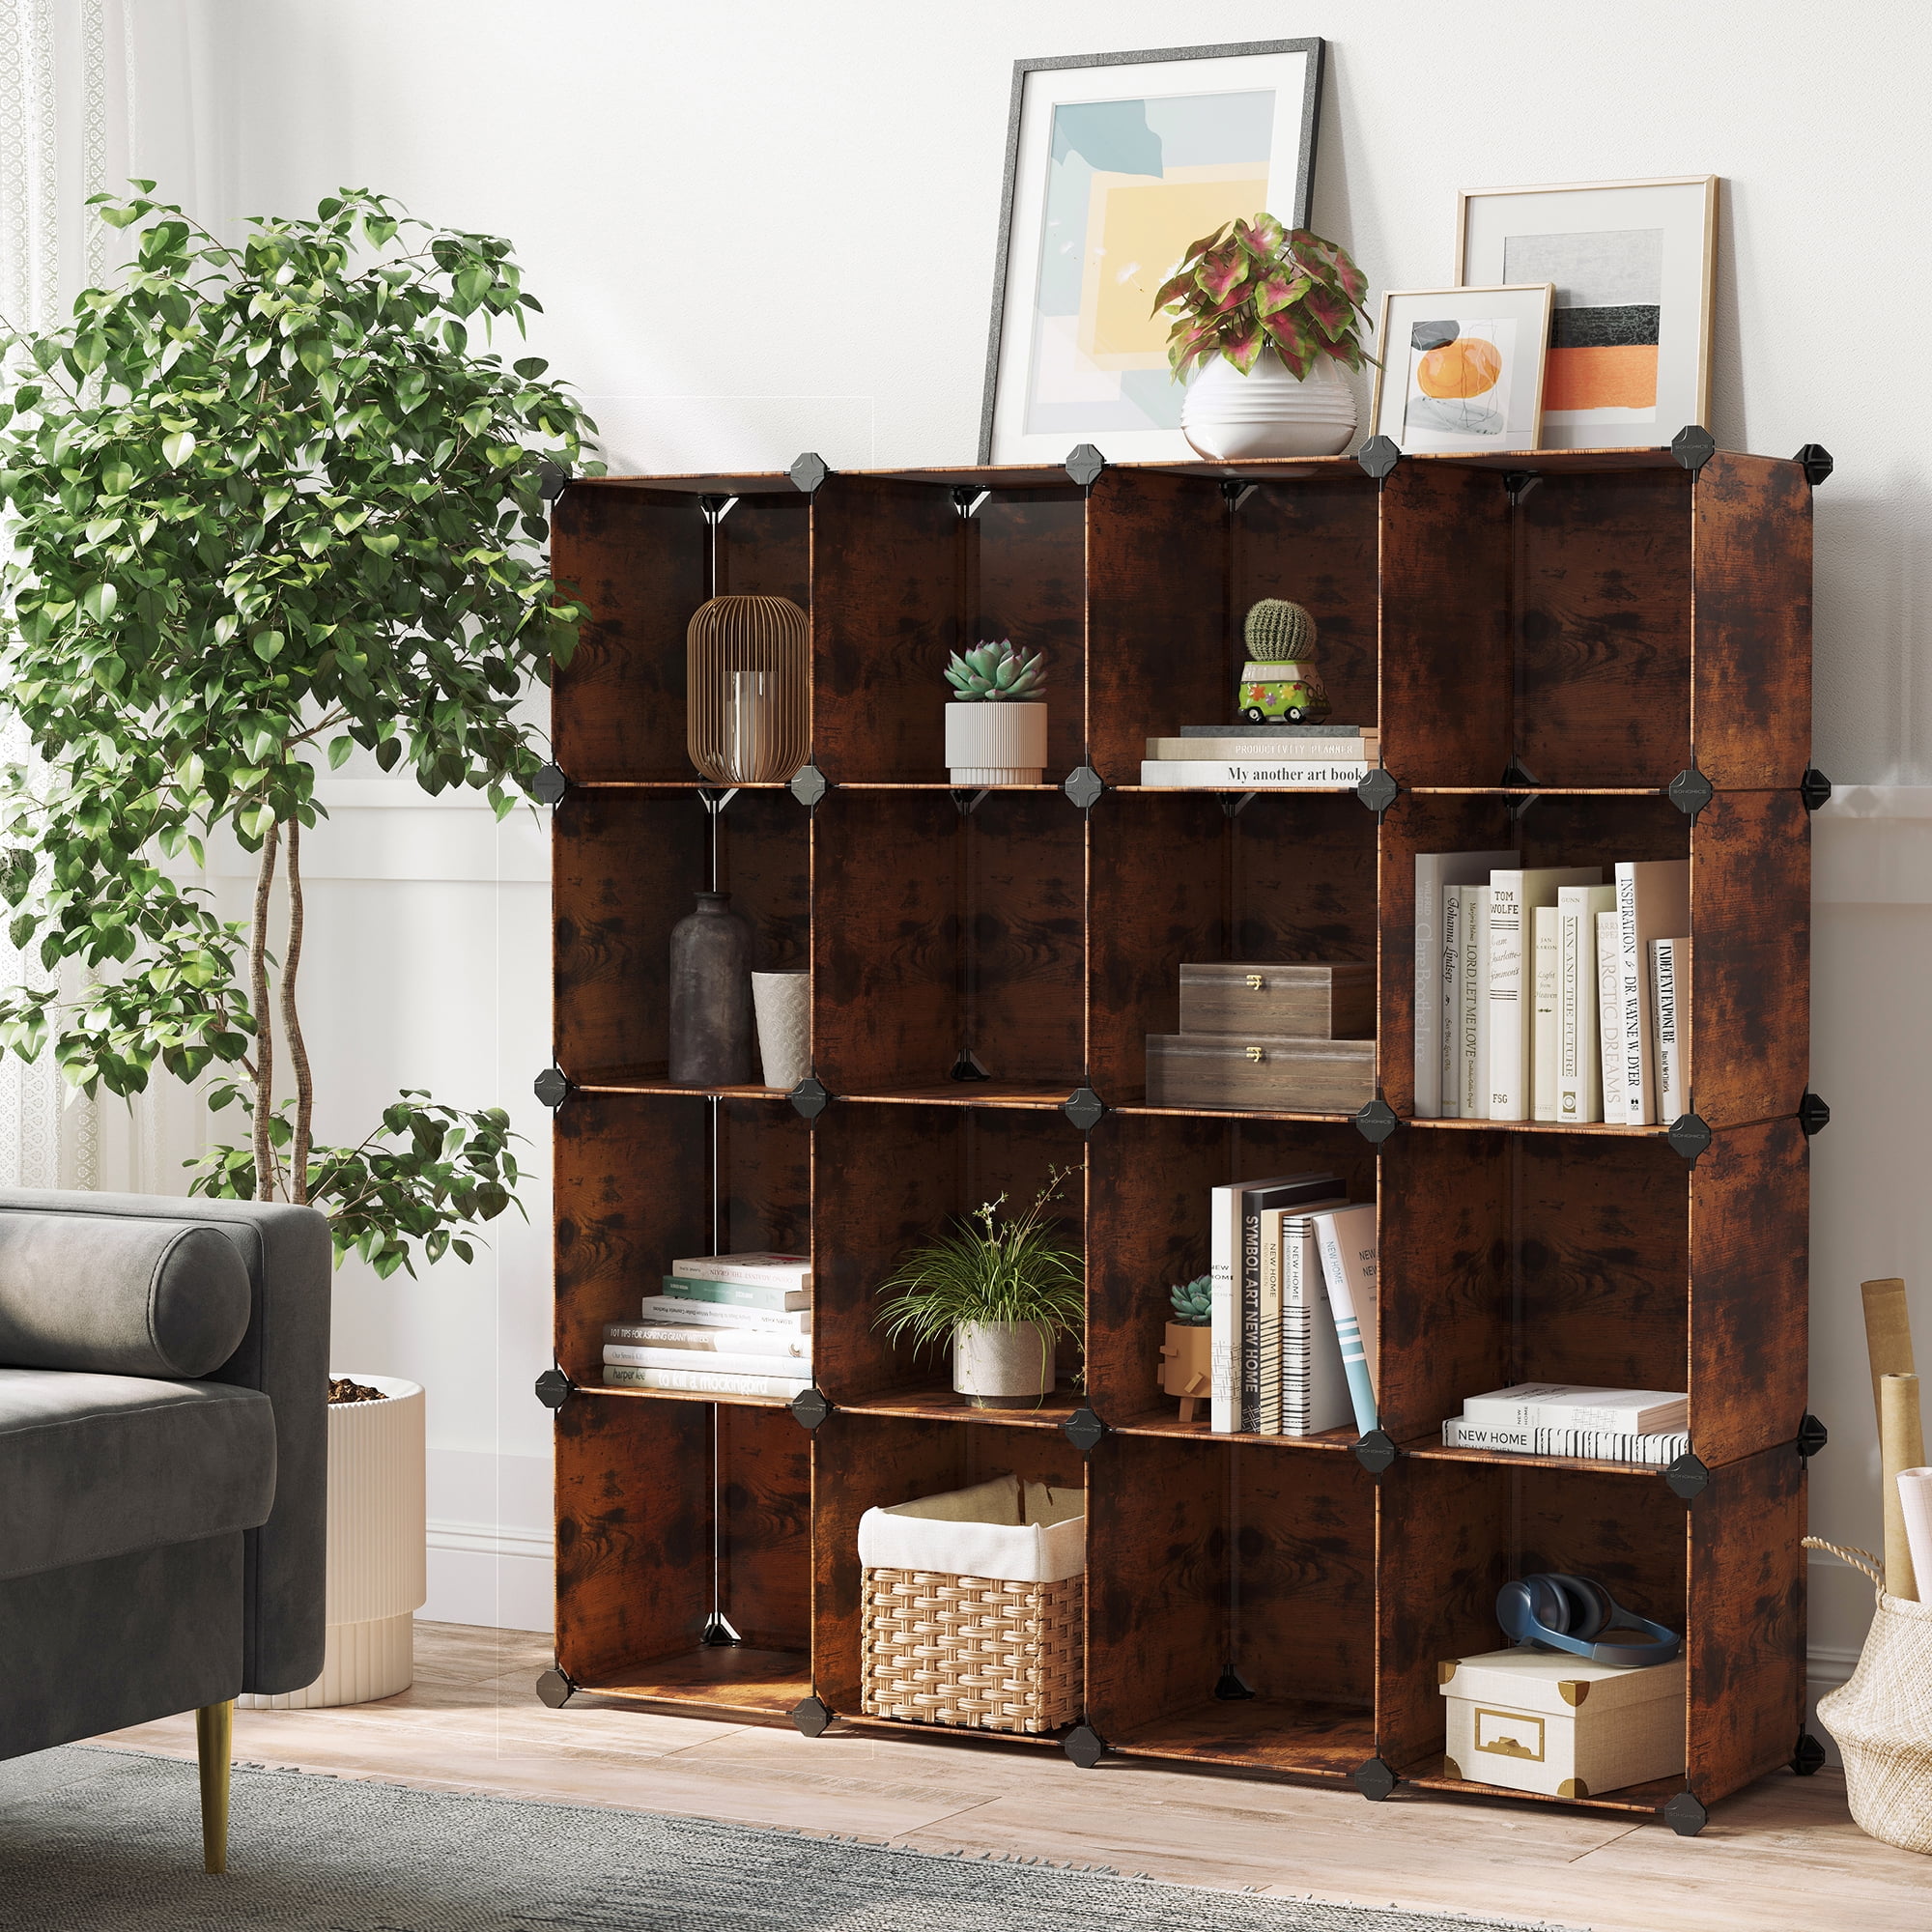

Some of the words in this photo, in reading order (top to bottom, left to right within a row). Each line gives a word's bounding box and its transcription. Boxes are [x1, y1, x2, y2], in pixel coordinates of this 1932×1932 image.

[1236, 745, 1304, 754] PRODUCTIVITY
[1312, 745, 1352, 754] PLANNER
[1229, 767, 1249, 783] My
[1253, 767, 1304, 781] another
[1307, 768, 1326, 781] art
[1331, 767, 1363, 781] book
[1491, 904, 1519, 914] WOLFE
[1494, 891, 1514, 901] TOM
[1446, 897, 1460, 943] Johanna
[1621, 878, 1635, 953] INSPIRATION
[1416, 923, 1433, 967] Clare
[1442, 946, 1459, 983] Lindsey
[1659, 946, 1674, 993] INDECENT
[1416, 969, 1433, 1024] Boothe
[1466, 981, 1477, 1004] LET
[1601, 949, 1618, 1020] ARCTIC
[1624, 976, 1637, 996] DR.
[1466, 1006, 1477, 1024] ME
[1626, 998, 1639, 1037] WAYNE
[1661, 996, 1675, 1044] EXPOSURE
[1465, 1027, 1477, 1058] LOVE
[1565, 1022, 1574, 1077] FUTURE
[1627, 1040, 1639, 1053] W.
[1604, 1028, 1621, 1103] DREAMS
[1628, 1056, 1641, 1087] DYER
[1492, 1094, 1508, 1103] FSG
[1245, 1215, 1259, 1275] SYMBOL
[1326, 1240, 1338, 1260] NEW
[1331, 1260, 1344, 1285] HOME
[1245, 1280, 1259, 1307] ART
[610, 1328, 620, 1337] 101
[621, 1329, 632, 1338] TIPS
[631, 1330, 642, 1339] FOR
[642, 1330, 668, 1341] ASPIRING
[667, 1332, 687, 1342] GRANT
[1245, 1311, 1259, 1345] NEW
[612, 1368, 635, 1381] harper
[658, 1373, 669, 1386] to
[672, 1373, 687, 1388] kill
[689, 1378, 697, 1389] a
[1245, 1350, 1259, 1393] HOME
[1458, 1429, 1488, 1442] NEW
[1491, 1432, 1527, 1446] HOME
